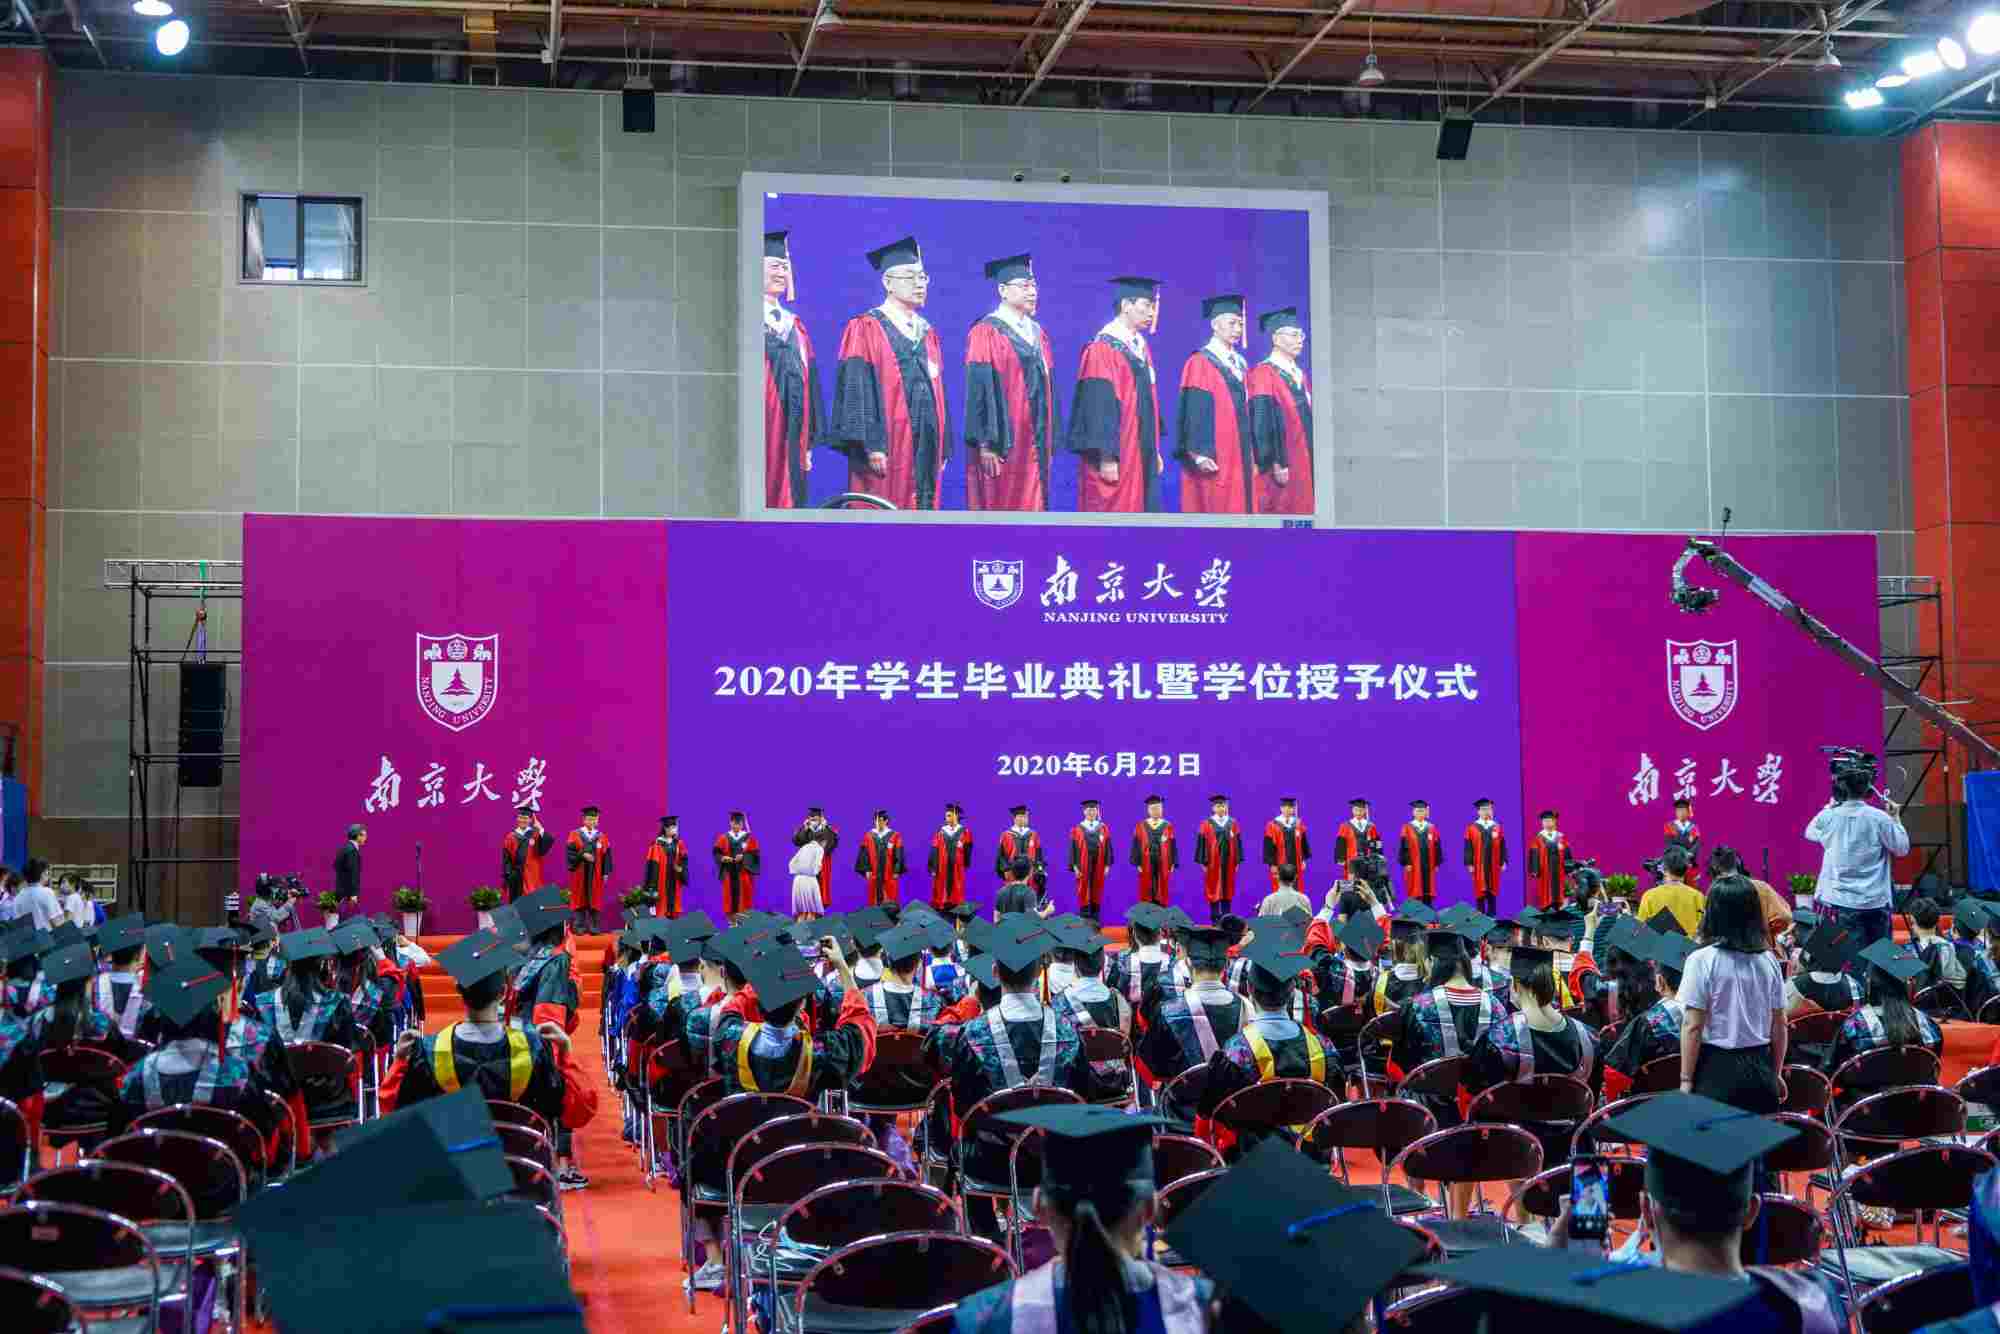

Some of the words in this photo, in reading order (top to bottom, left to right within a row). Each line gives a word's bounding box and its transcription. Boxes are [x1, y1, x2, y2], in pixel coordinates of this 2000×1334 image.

[1043, 611, 1121, 624] NANJING
[1126, 611, 1229, 624] UNIVERSITY
[714, 660, 1478, 701] 2020年学生毕业典礼暨学位授予仪式
[997, 751, 1201, 778] 2020年6月22日
